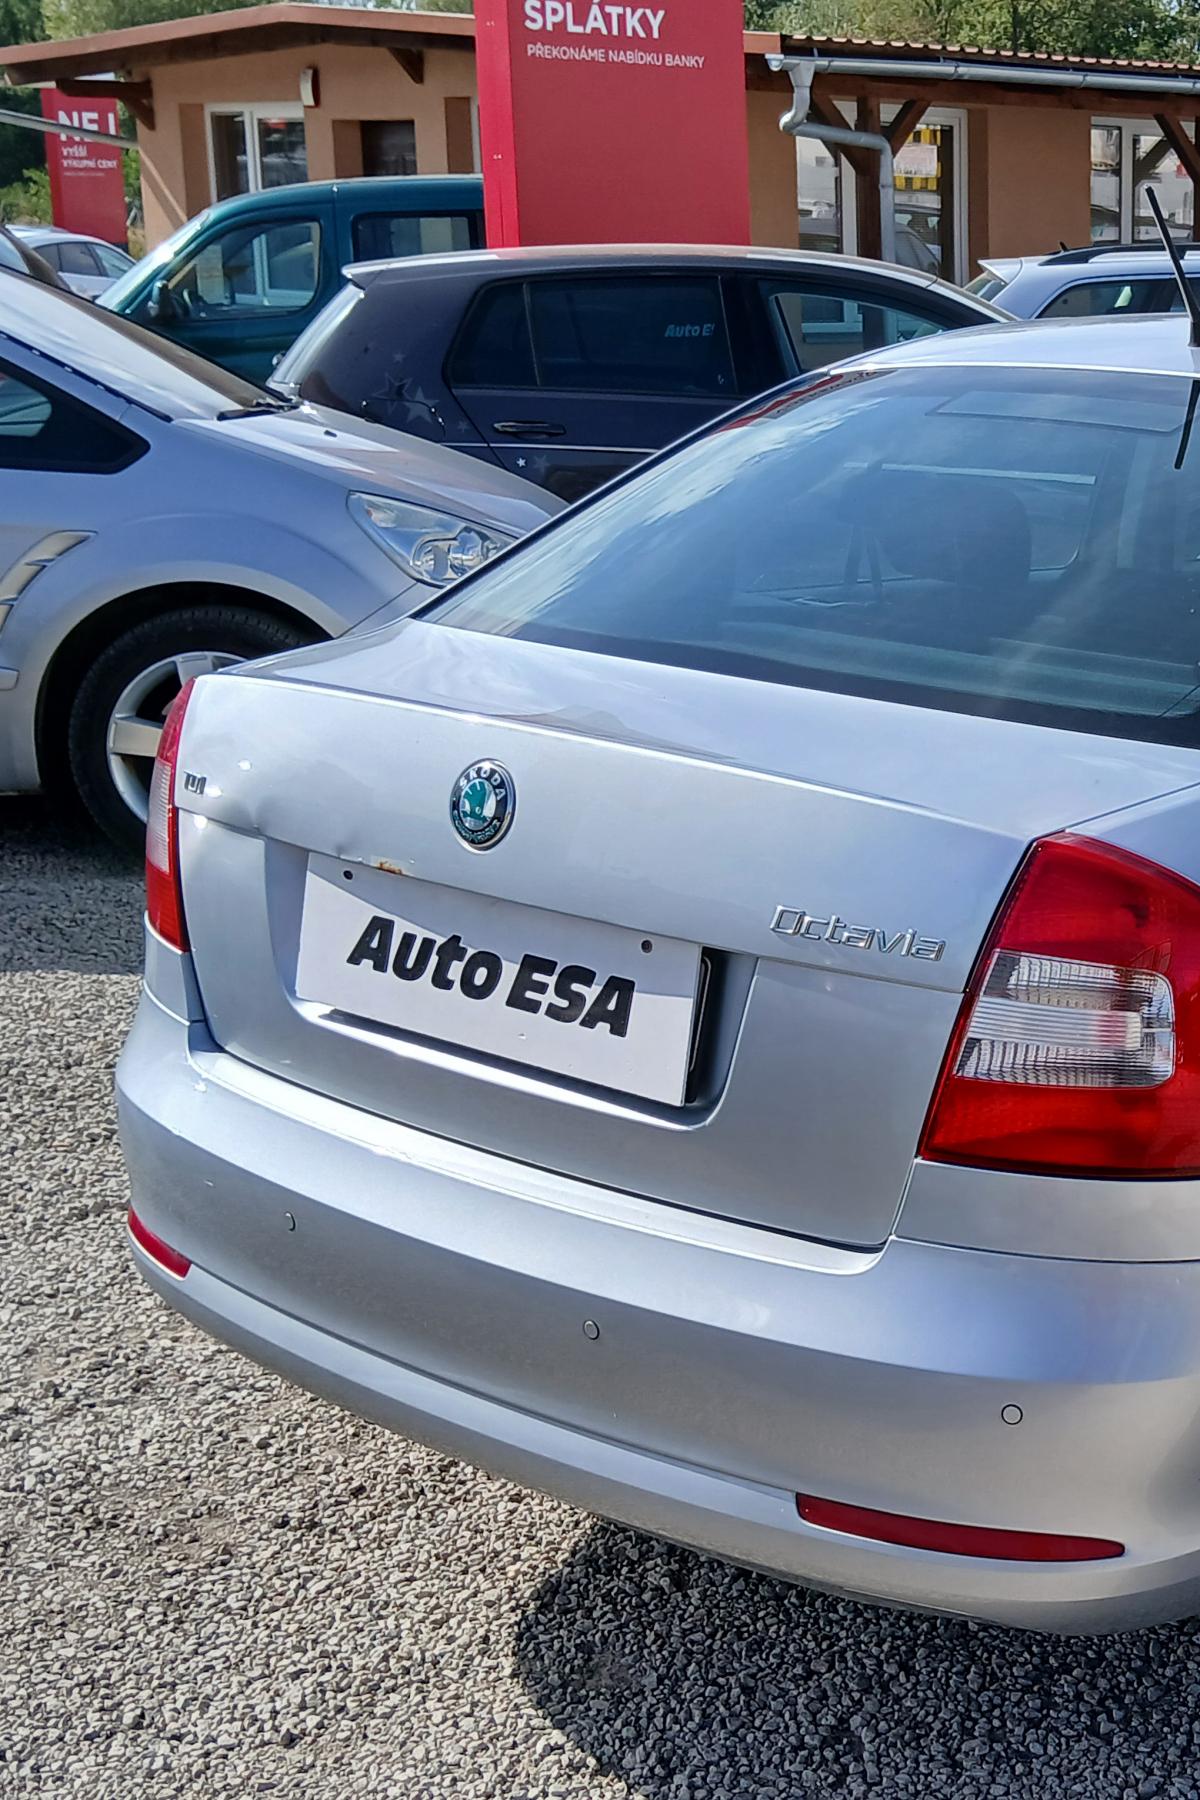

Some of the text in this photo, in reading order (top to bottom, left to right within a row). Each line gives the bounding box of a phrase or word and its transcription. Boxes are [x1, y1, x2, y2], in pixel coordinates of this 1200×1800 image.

[524, 0, 665, 39] SPLÁTKY
[527, 42, 705, 68] PŘEKONÁME NABÍDKU BANKY
[769, 904, 946, 961] Octavia
[346, 915, 637, 1038] Auto ESA
